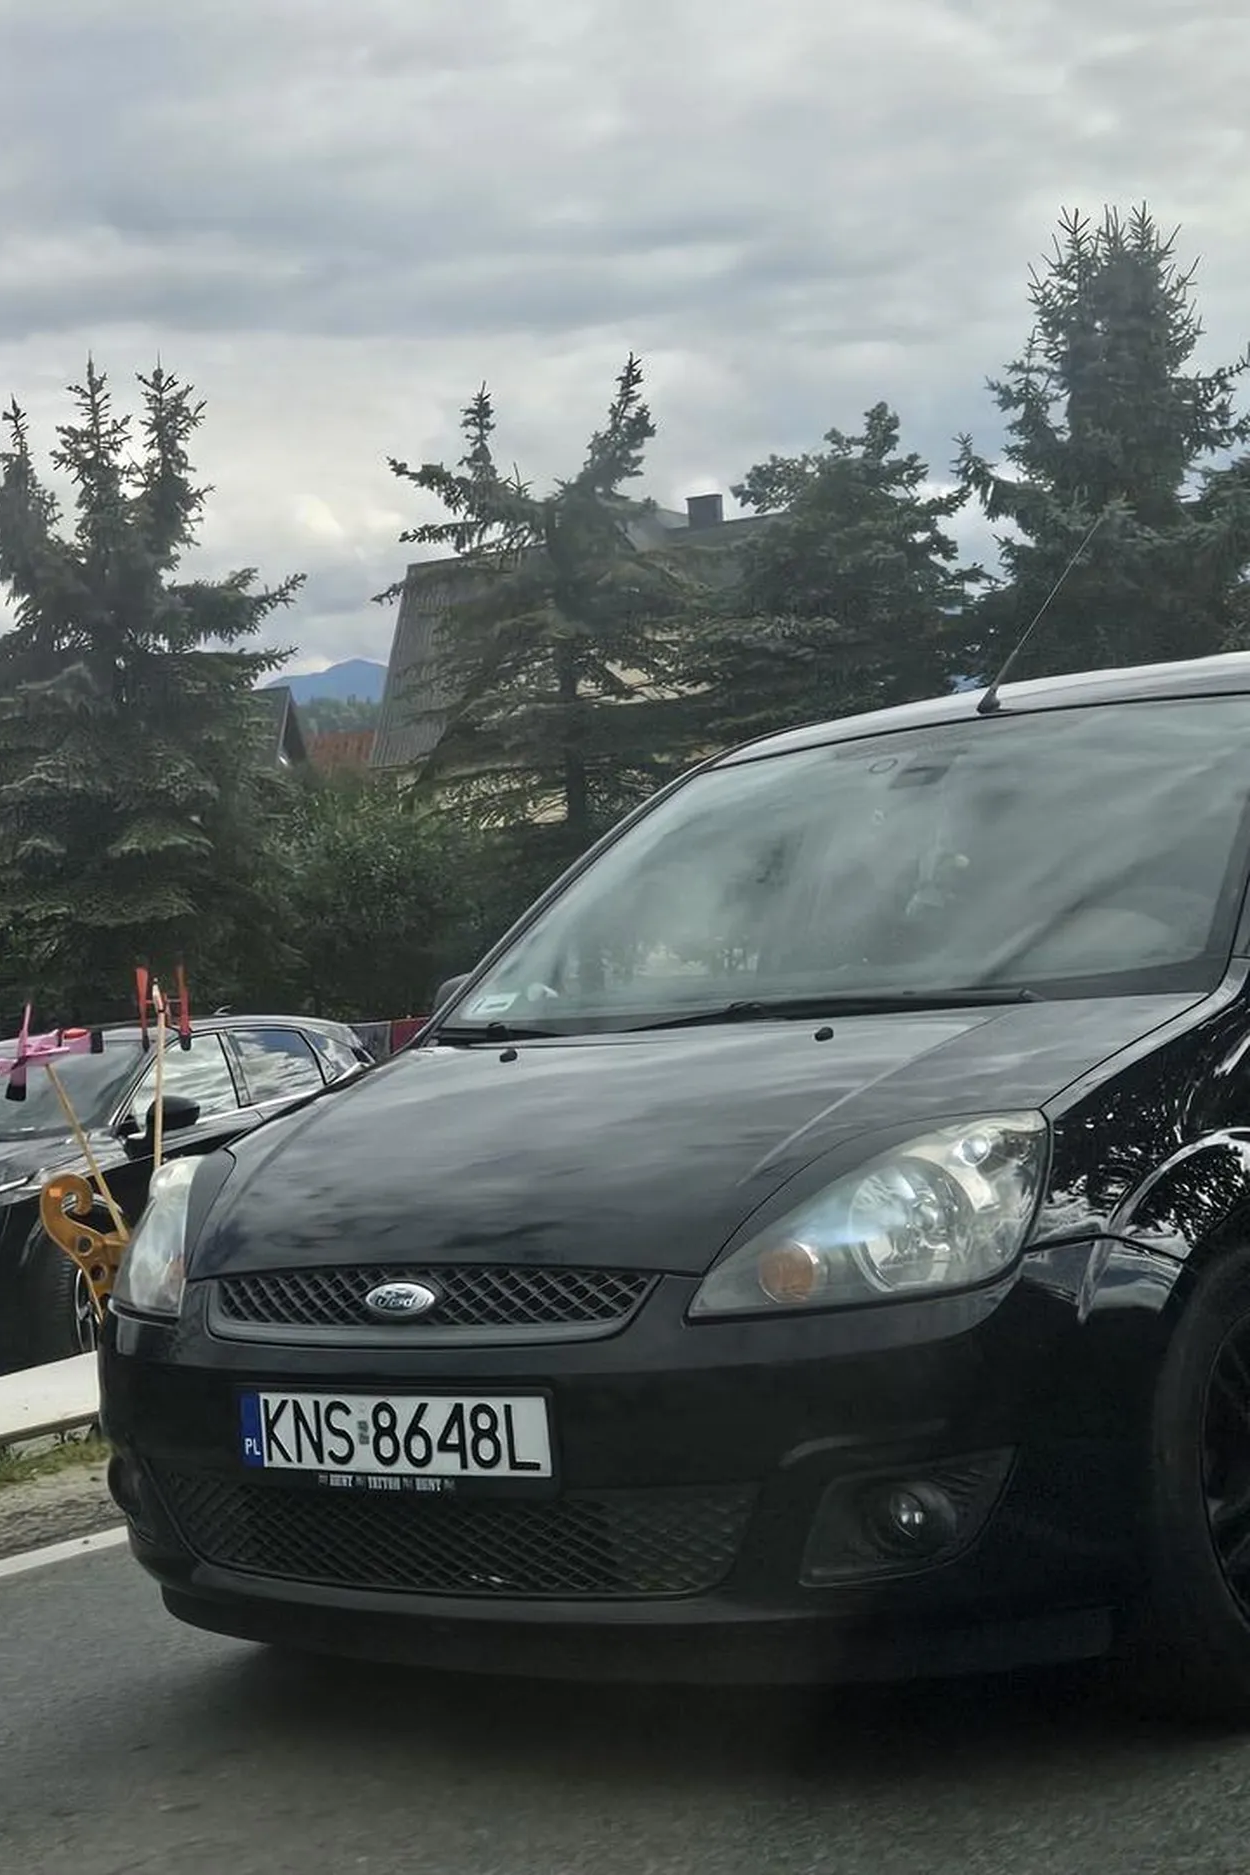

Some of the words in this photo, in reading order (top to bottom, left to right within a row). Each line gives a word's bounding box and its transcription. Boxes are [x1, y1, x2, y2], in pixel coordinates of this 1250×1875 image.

[375, 1289, 420, 1310] Ford
[263, 1399, 355, 1466] KNS
[371, 1401, 541, 1471] 8648L
[244, 1438, 261, 1456] PL
